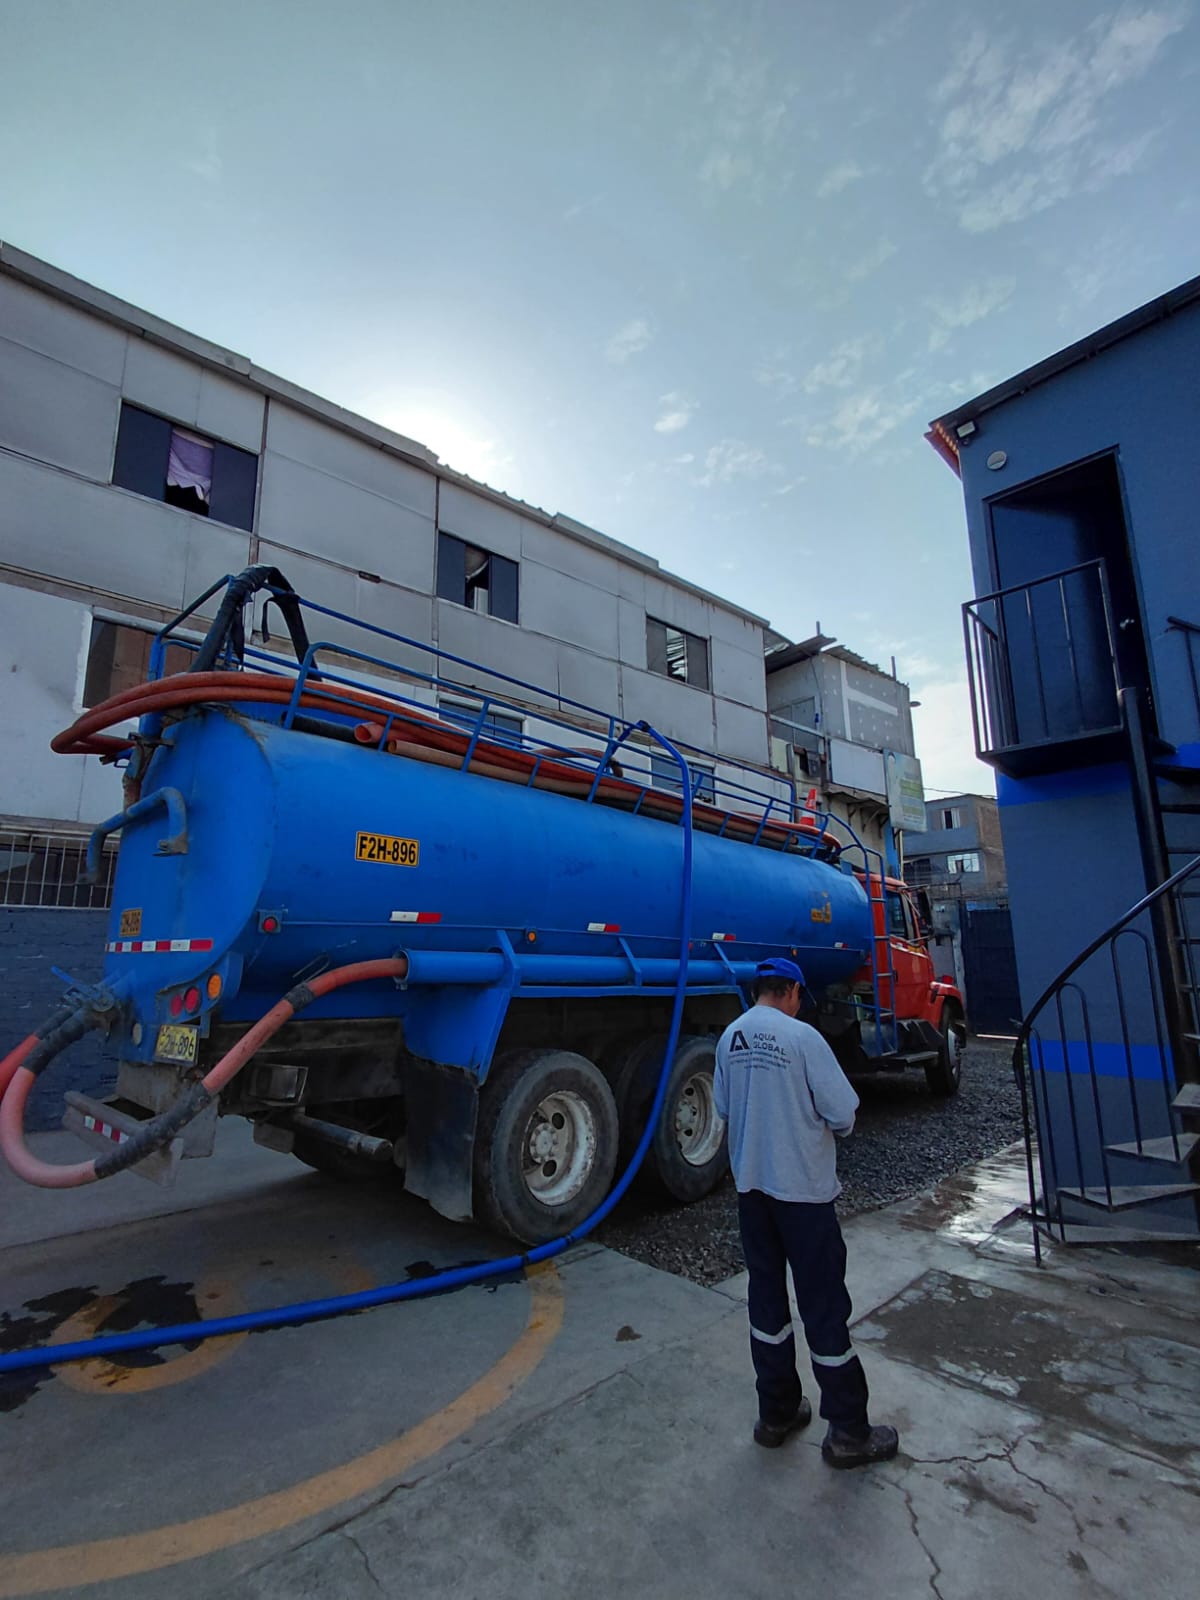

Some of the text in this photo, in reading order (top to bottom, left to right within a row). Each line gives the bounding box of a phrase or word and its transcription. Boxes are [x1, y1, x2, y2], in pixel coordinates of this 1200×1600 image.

[359, 835, 416, 864] F2H-896
[753, 1033, 776, 1042] AQUA
[753, 1042, 786, 1055] GLOBAL
